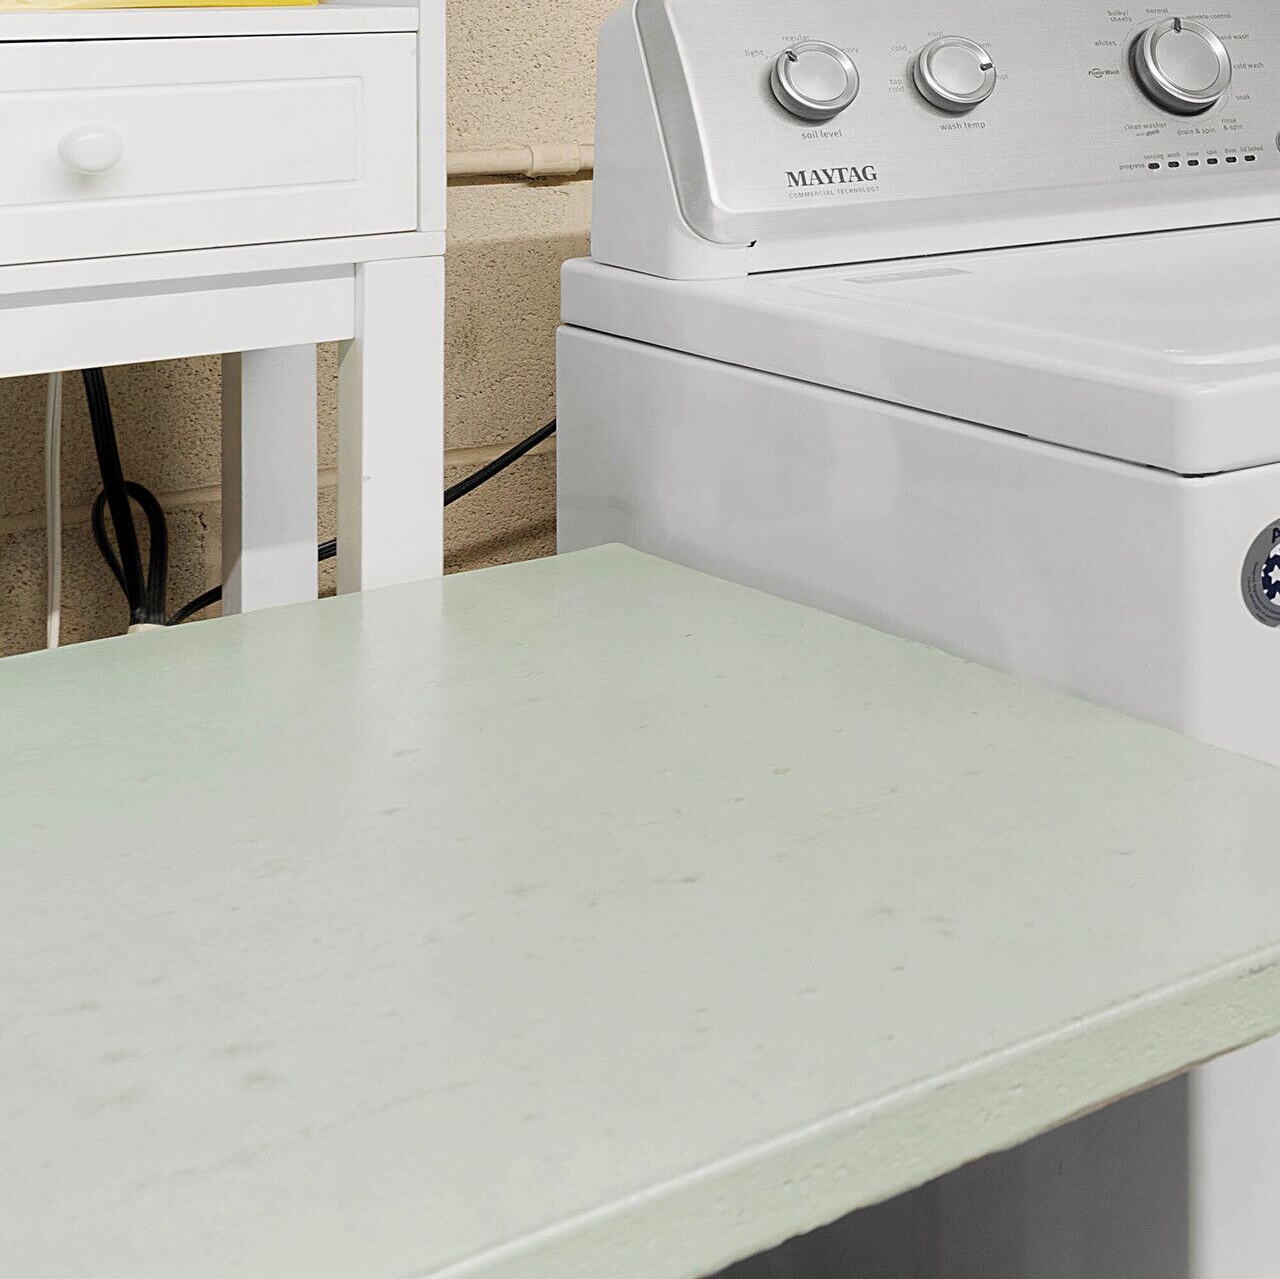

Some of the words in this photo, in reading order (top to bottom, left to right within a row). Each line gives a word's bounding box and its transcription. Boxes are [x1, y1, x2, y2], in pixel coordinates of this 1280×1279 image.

[940, 122, 962, 131] wash
[964, 121, 986, 131] temp
[801, 130, 819, 140] soil
[820, 129, 843, 139] level
[785, 164, 878, 188] MAYTAG
[788, 191, 834, 200] COMMERCIAL
[836, 186, 880, 196] TECHNOLOGY
